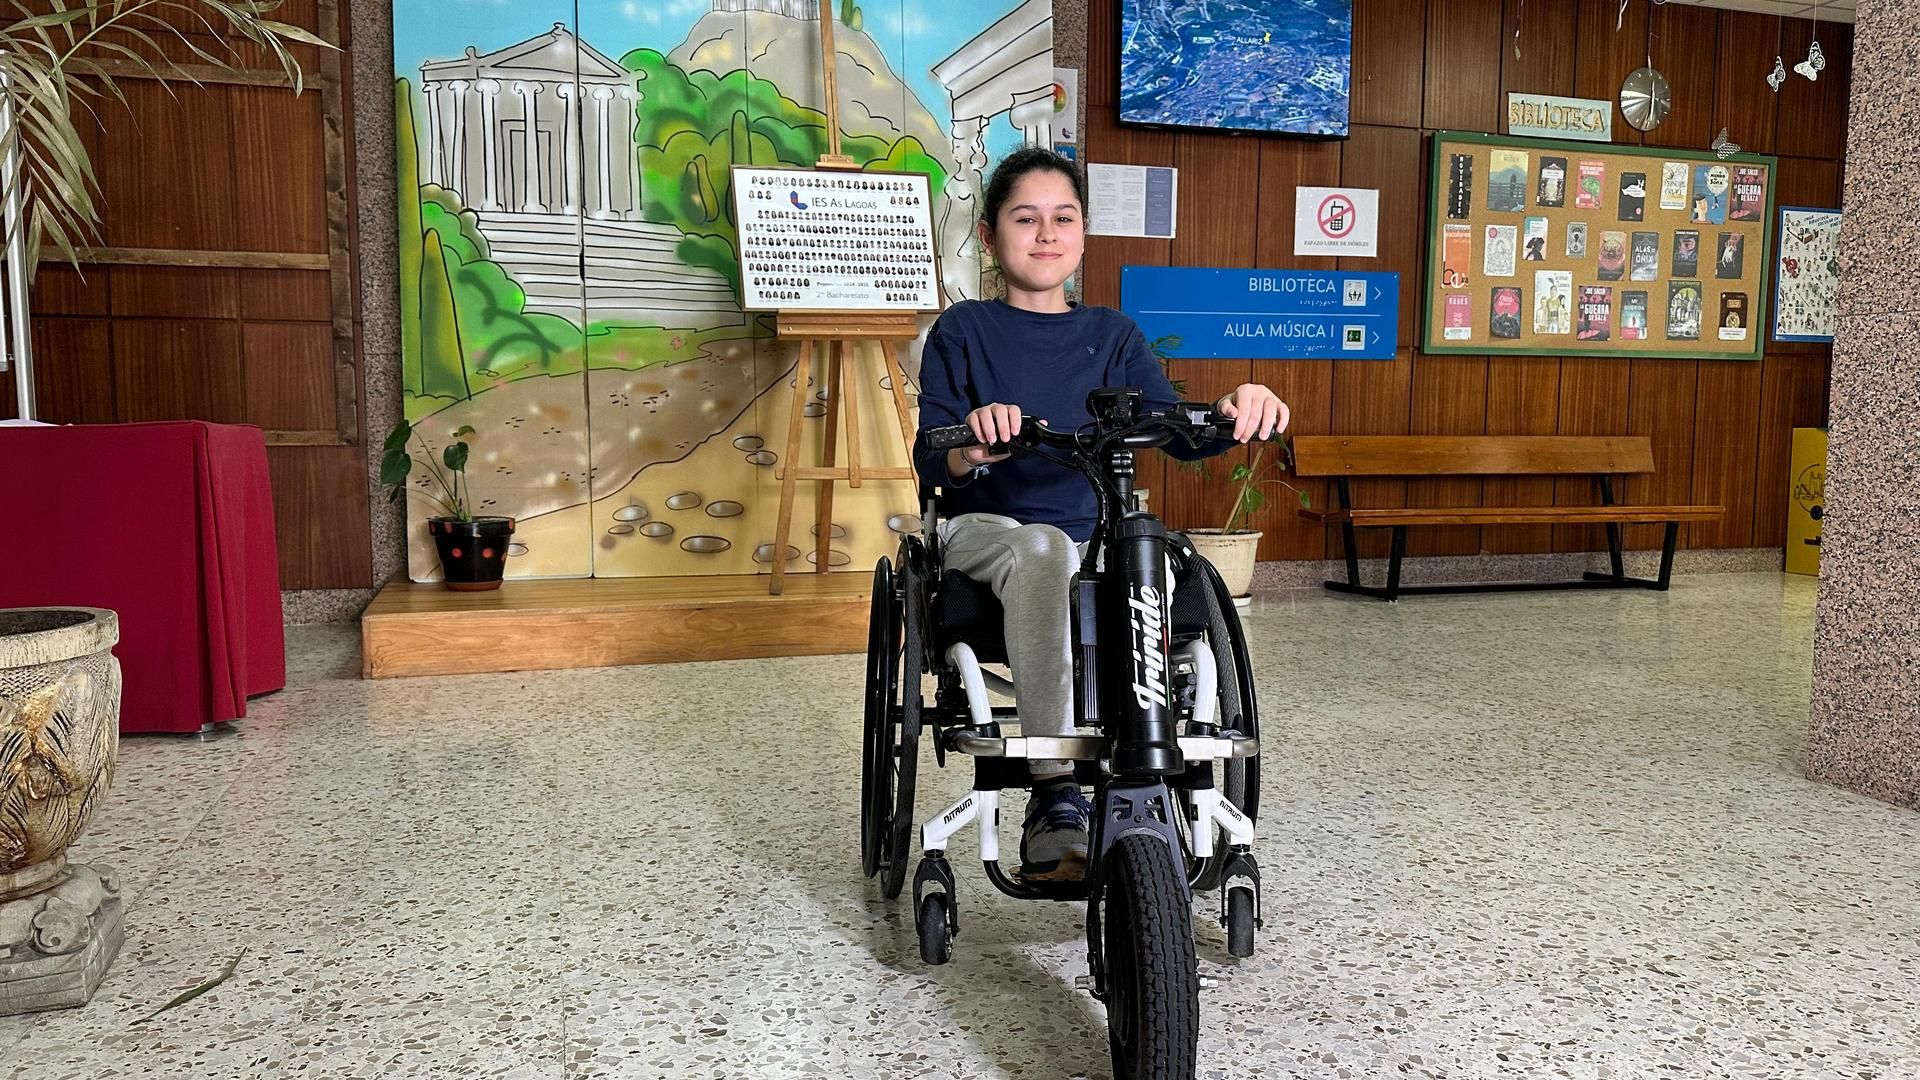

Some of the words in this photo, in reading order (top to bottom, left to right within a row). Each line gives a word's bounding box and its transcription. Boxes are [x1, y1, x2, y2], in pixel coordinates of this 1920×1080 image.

[1237, 36, 1263, 45] ALLARIZ
[1509, 100, 1605, 133] BIBLIOTECA
[1737, 184, 1761, 195] GUERRA
[811, 197, 827, 207] IES
[1635, 245, 1650, 253] ALAS
[1249, 277, 1336, 293] BIBLIOTECA
[826, 291, 870, 300] Bacharelato
[1584, 304, 1609, 315] GUERRA
[1224, 323, 1265, 338] AULA
[1269, 320, 1326, 338] MÚSICA
